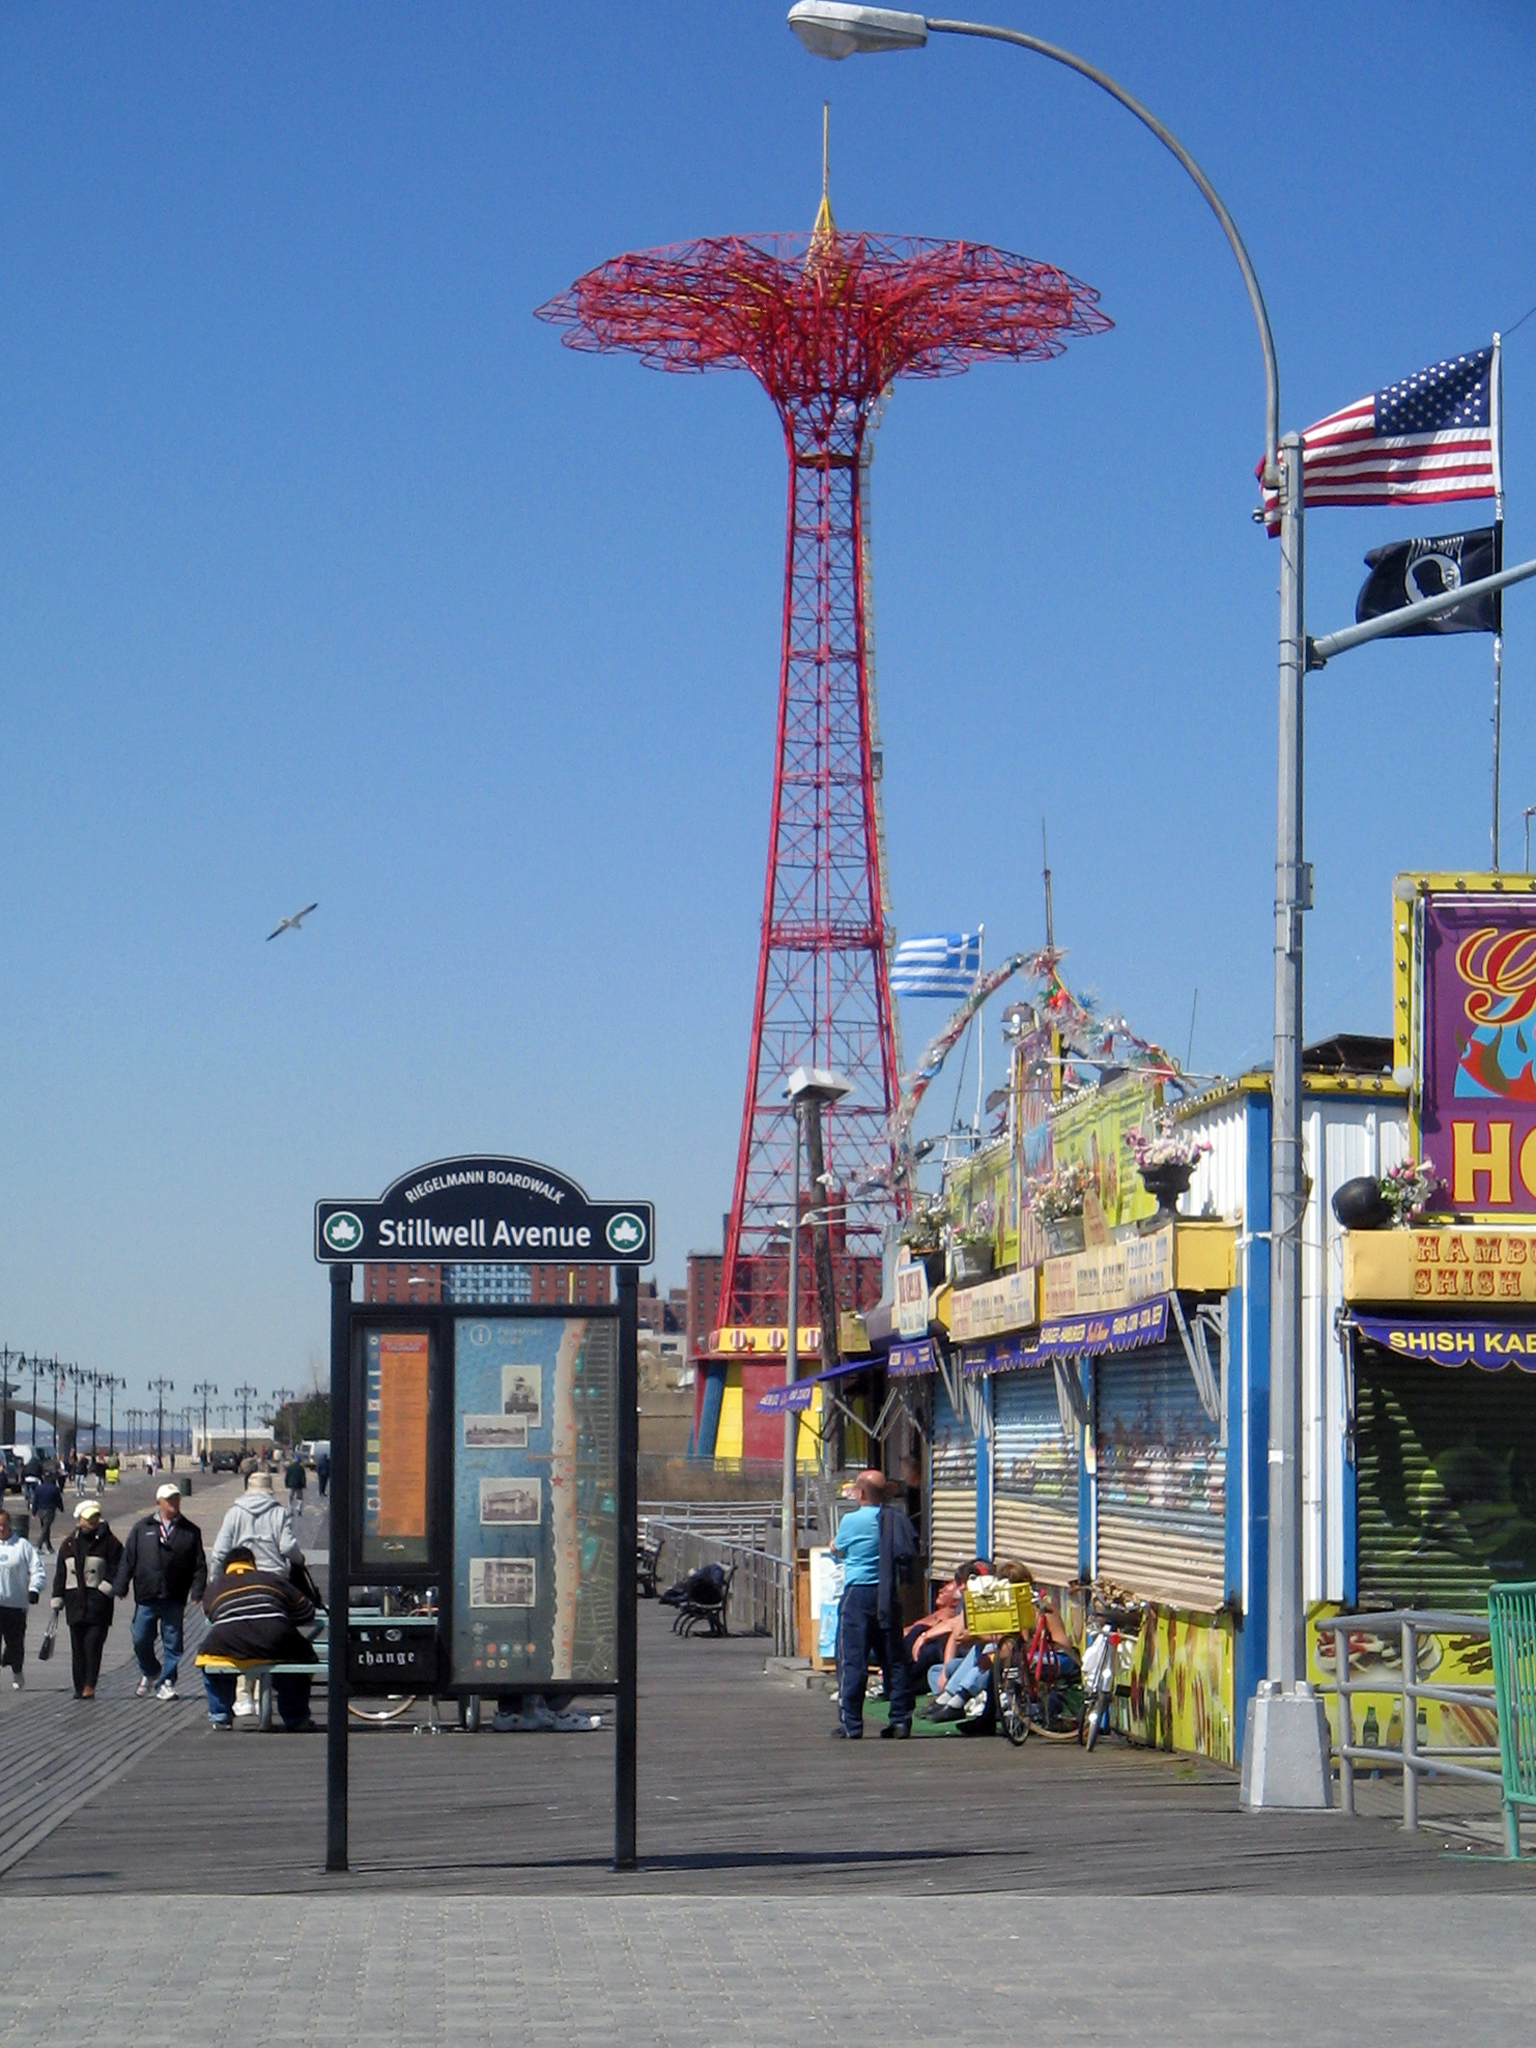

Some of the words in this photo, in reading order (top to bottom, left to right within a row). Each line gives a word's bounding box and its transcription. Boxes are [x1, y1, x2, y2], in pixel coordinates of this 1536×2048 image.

[1451, 1119, 1536, 1205] H
[404, 1171, 484, 1203] RIEGELMANN
[487, 1171, 565, 1204] BOARDWALK
[378, 1218, 486, 1247] Stillwell
[492, 1220, 591, 1247] Avenue
[1416, 1234, 1536, 1264] HAMB
[1414, 1268, 1521, 1296] SHISH
[1389, 1330, 1475, 1352] SHISH
[358, 1651, 415, 1665] change
